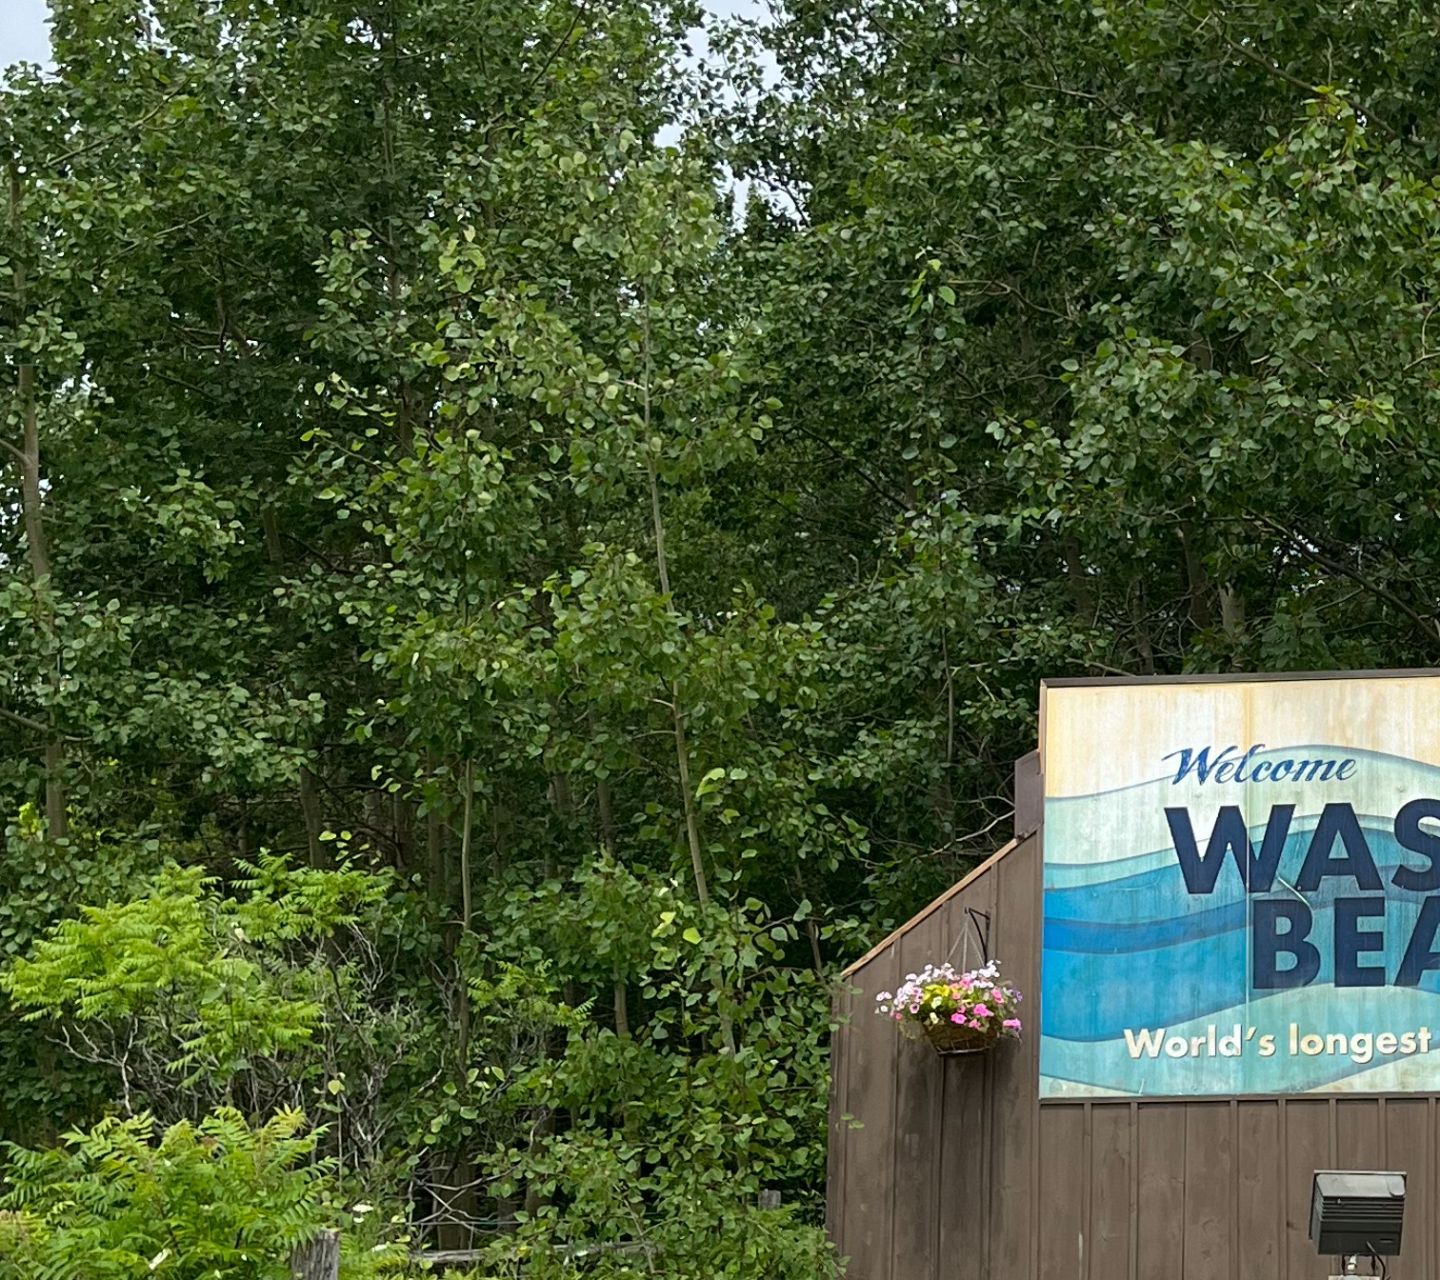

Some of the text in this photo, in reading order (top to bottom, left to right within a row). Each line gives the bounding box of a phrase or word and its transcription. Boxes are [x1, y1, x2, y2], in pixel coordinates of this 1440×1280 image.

[1161, 743, 1357, 786] Welcome
[1123, 1023, 1277, 1060] World's
[1288, 1023, 1432, 1065] longest
